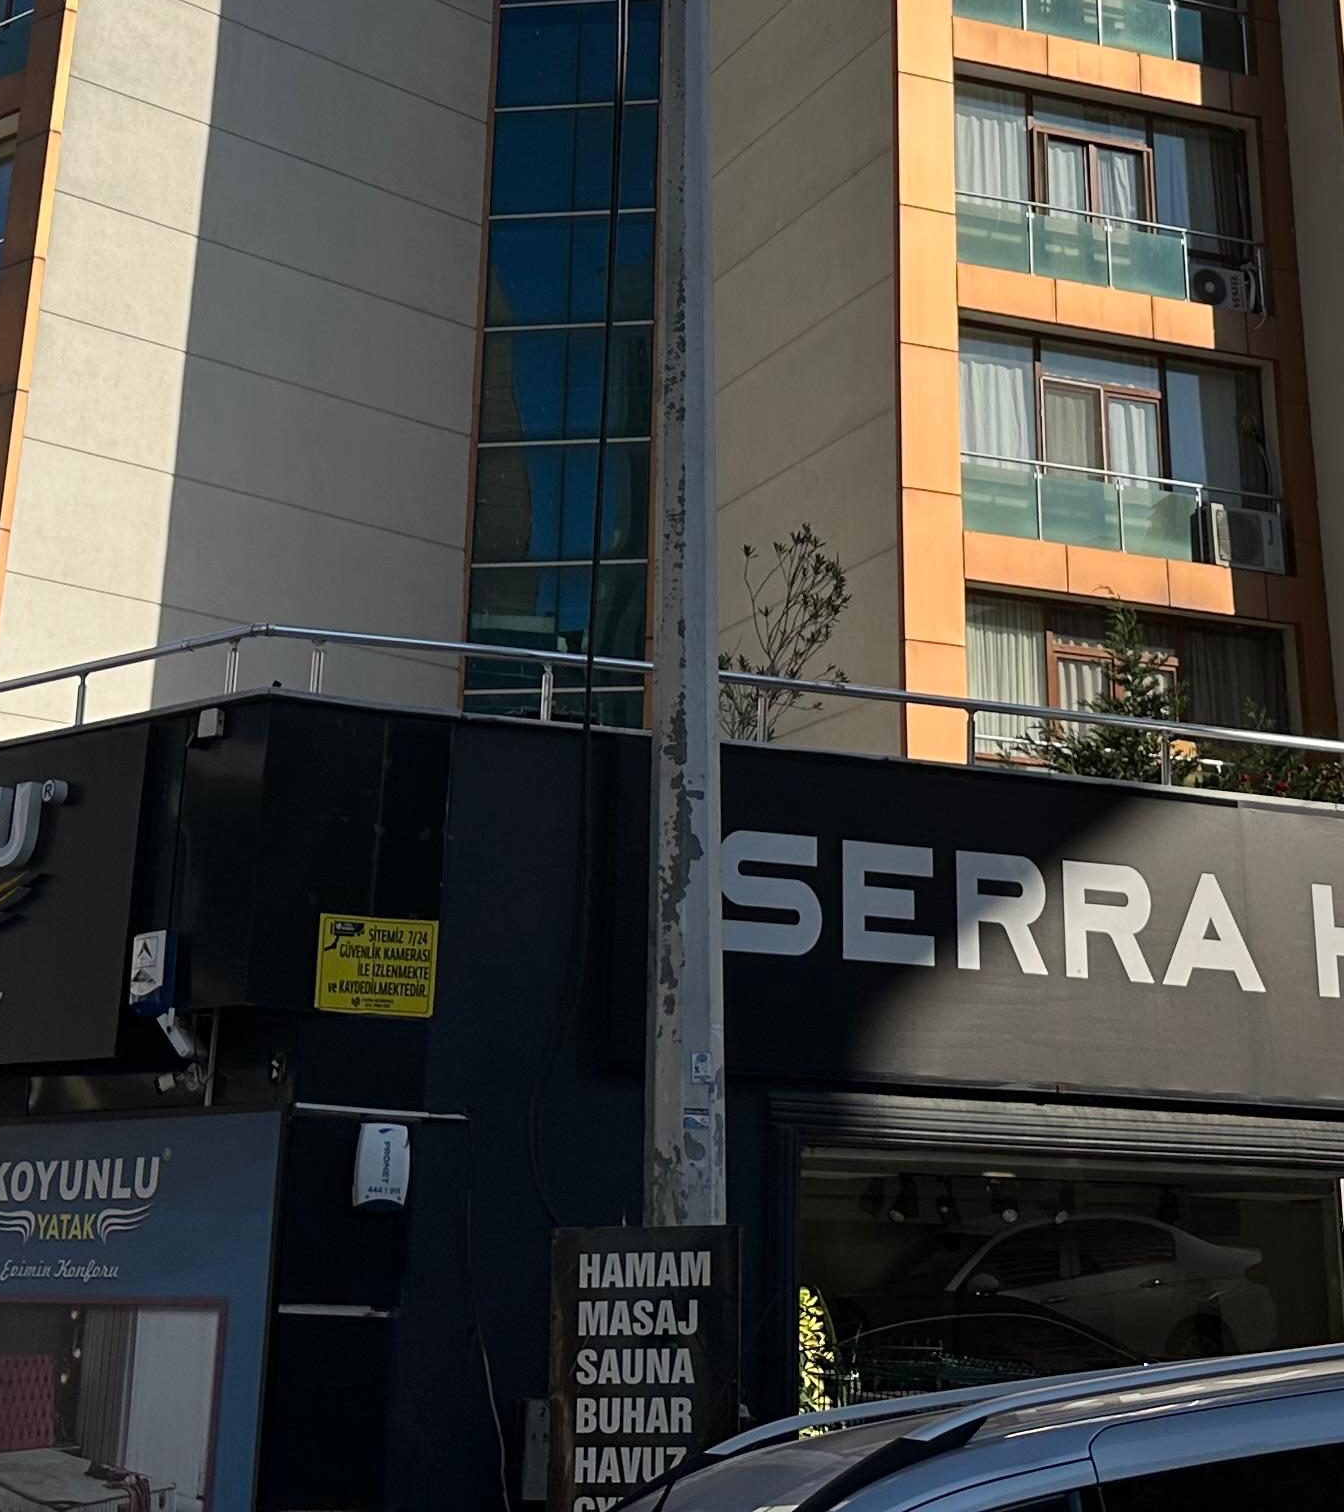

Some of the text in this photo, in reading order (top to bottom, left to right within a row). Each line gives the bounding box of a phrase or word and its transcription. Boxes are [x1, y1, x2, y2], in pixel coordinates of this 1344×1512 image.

[722, 831, 1265, 993] SERRA
[339, 941, 431, 963] GÜVENLİK KAMERASI
[369, 926, 428, 946] SİTEMİZ 7/24
[382, 1141, 392, 1185] PRONET
[36, 1213, 97, 1241] YATAK
[0, 1259, 120, 1283] Evimin Konforu
[578, 1251, 711, 1288] HAMAM
[577, 1299, 698, 1336] MASAJ
[575, 1348, 695, 1384] SAUNA
[575, 1397, 693, 1434] BUHAR
[574, 1446, 688, 1484] HAVUZ
